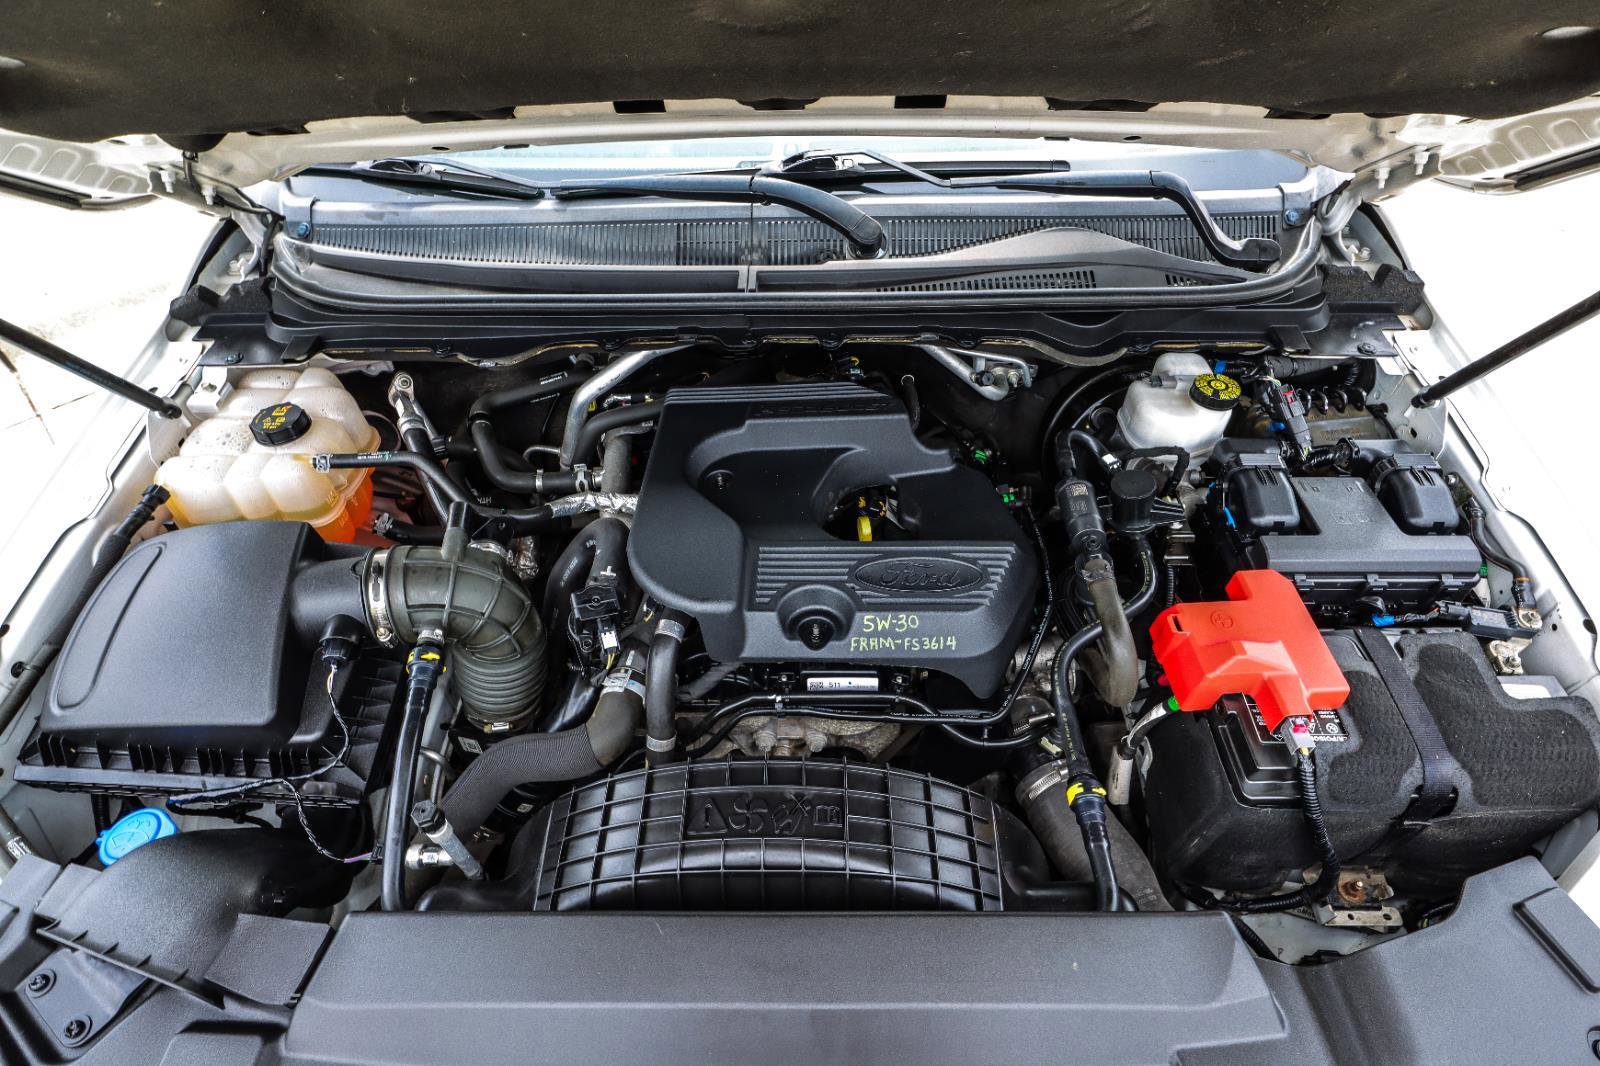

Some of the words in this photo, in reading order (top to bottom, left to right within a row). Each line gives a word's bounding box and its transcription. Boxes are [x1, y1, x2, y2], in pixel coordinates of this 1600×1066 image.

[880, 562, 961, 586] Ford
[863, 613, 919, 632] 5W-30
[850, 635, 957, 651] FRAM-FS3614
